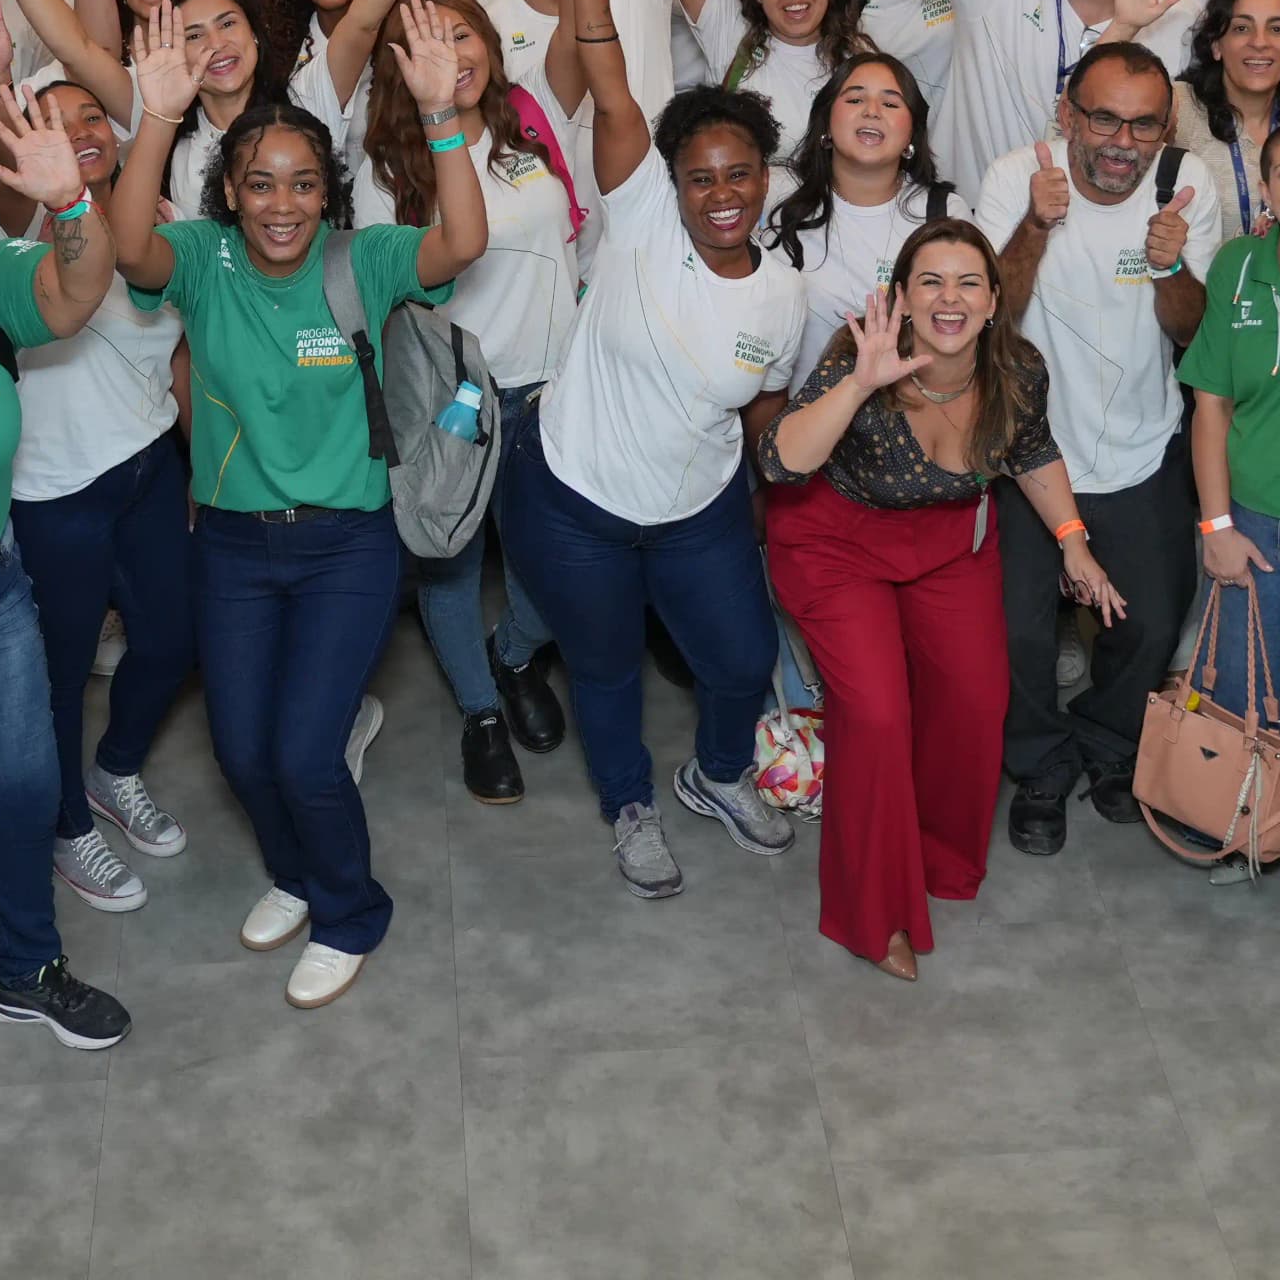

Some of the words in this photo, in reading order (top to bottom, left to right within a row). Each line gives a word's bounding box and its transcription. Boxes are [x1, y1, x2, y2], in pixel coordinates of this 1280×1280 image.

[297, 349, 304, 357] E
[305, 347, 339, 357] RENDA
[298, 355, 353, 366] PETROBRAS
[740, 353, 765, 365] RENDA
